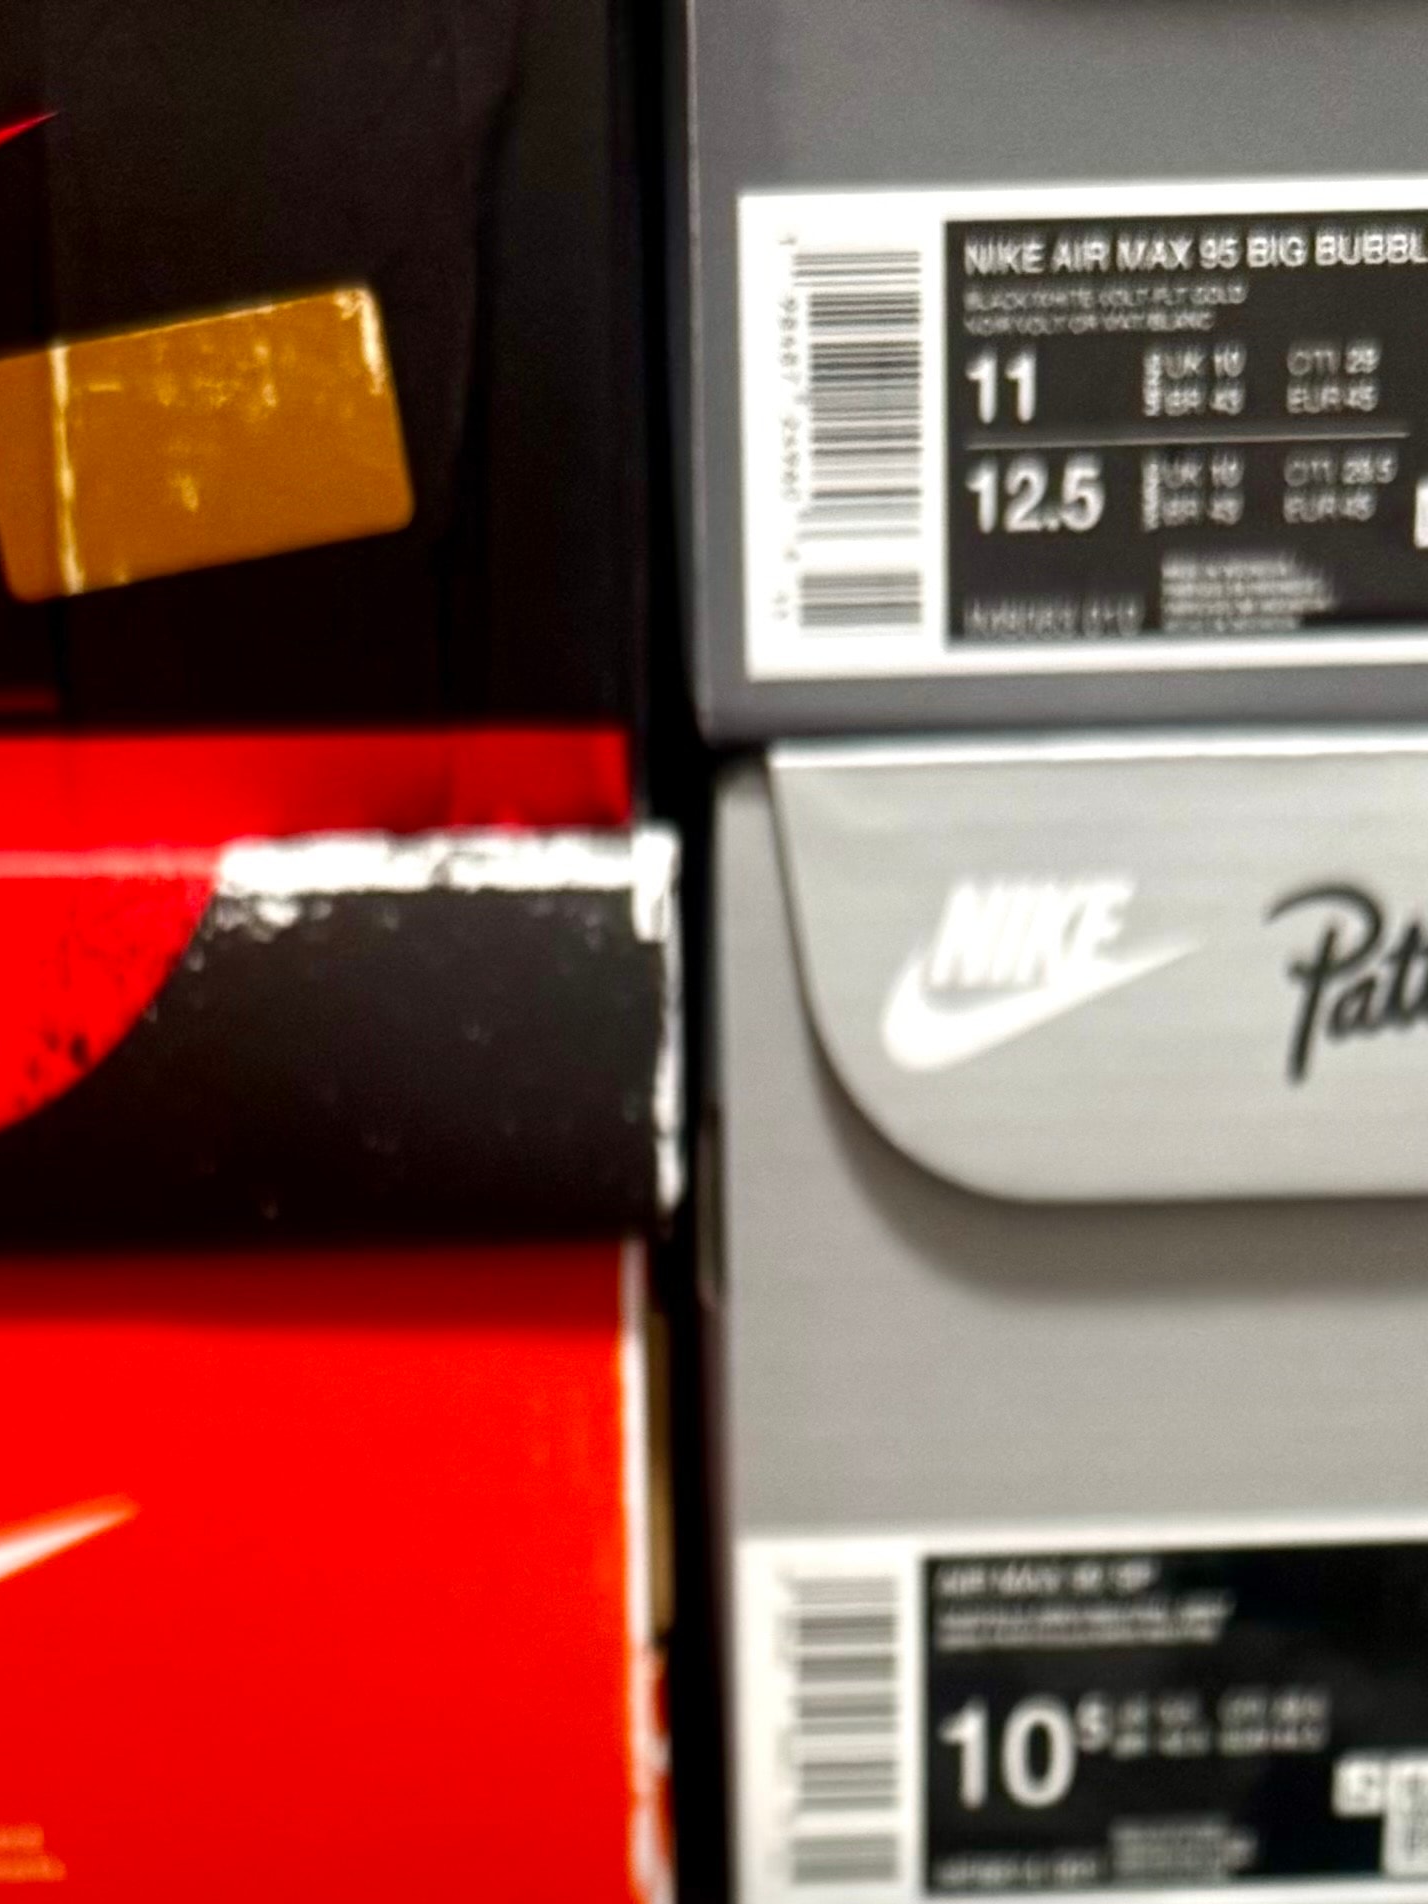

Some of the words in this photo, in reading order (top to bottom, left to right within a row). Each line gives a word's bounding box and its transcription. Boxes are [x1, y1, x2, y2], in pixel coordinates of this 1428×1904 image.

[964, 236, 1046, 275] NIKE
[1052, 237, 1111, 272] AIR
[1117, 235, 1194, 271] MAX
[1199, 234, 1240, 270] 95
[1246, 232, 1307, 269] BIG
[967, 347, 1037, 424] 11
[966, 451, 1105, 533] 12.5
[924, 872, 1139, 990] NIKE
